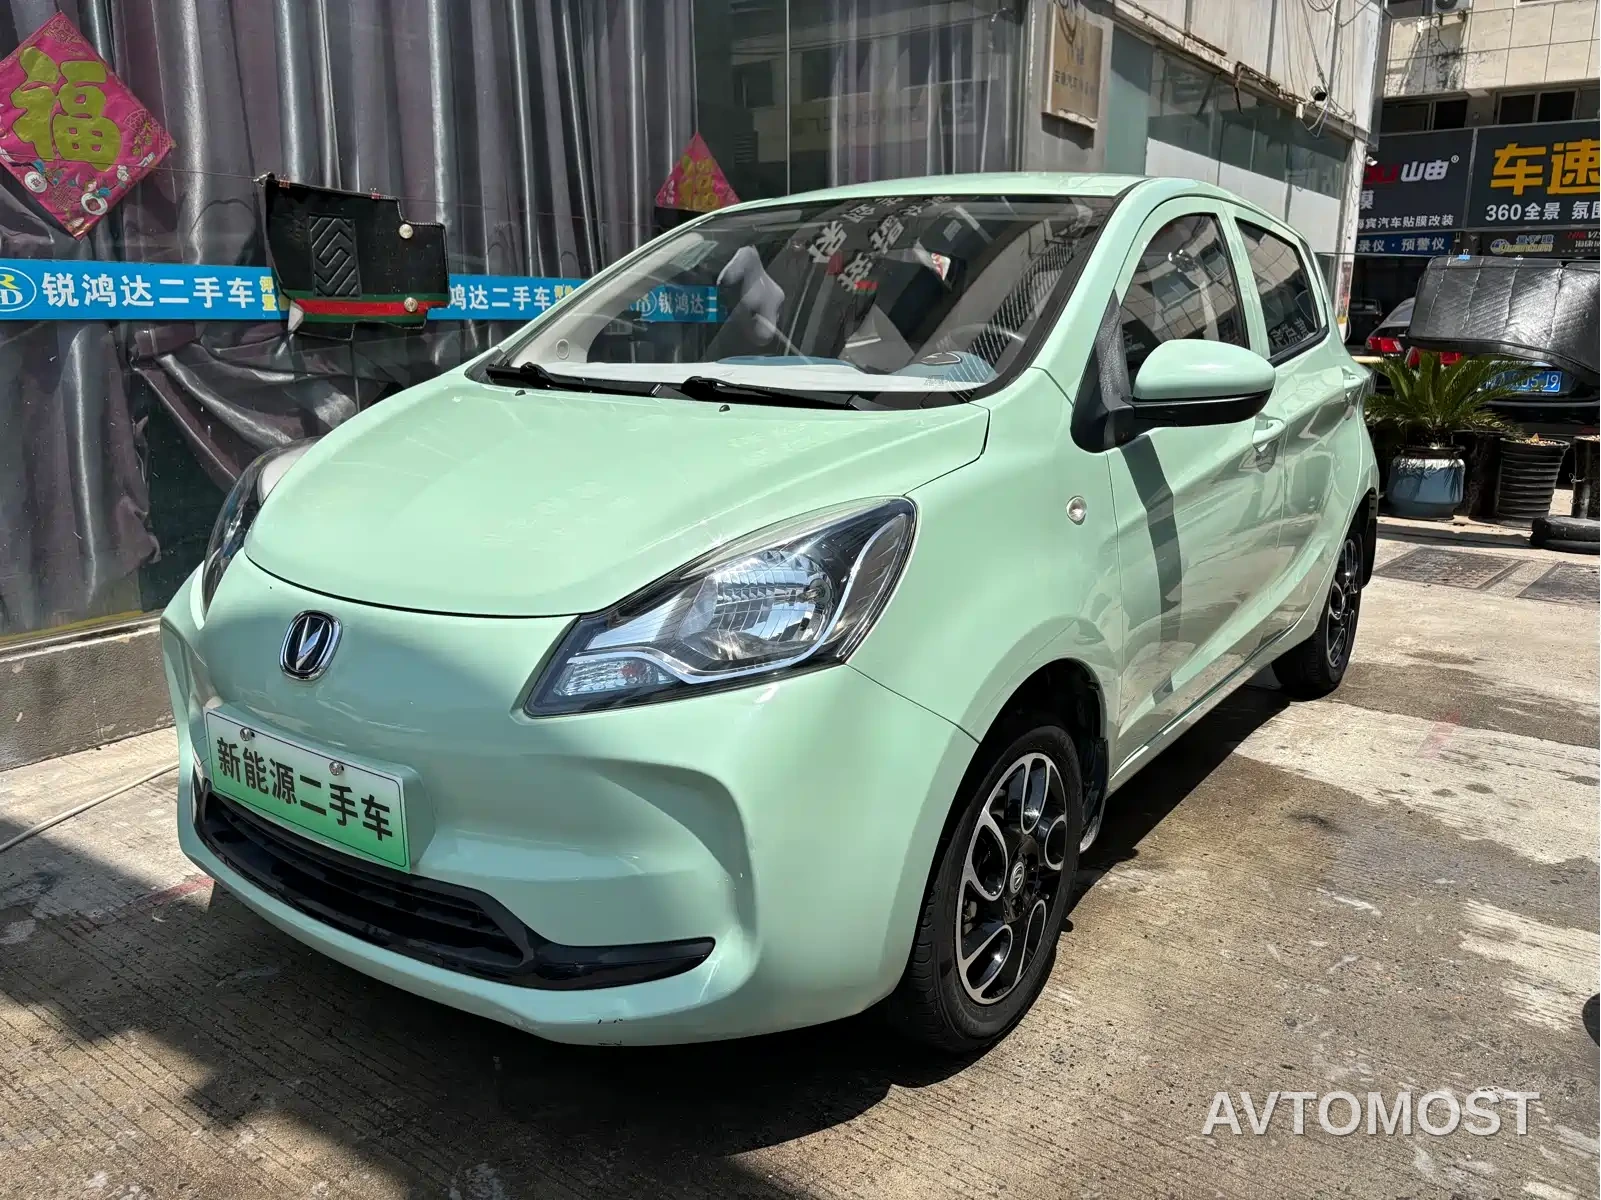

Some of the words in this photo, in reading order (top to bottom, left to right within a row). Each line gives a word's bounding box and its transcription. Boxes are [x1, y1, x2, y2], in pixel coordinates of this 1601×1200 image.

[10, 46, 121, 172] 福
[1401, 160, 1449, 182] 山由
[1490, 139, 1600, 196] 车速
[1485, 202, 1560, 221] 360全景
[41, 272, 256, 309] 锐鸿达二手车
[447, 284, 552, 311] 鸿达二手车
[217, 737, 393, 841] 新能源二手车
